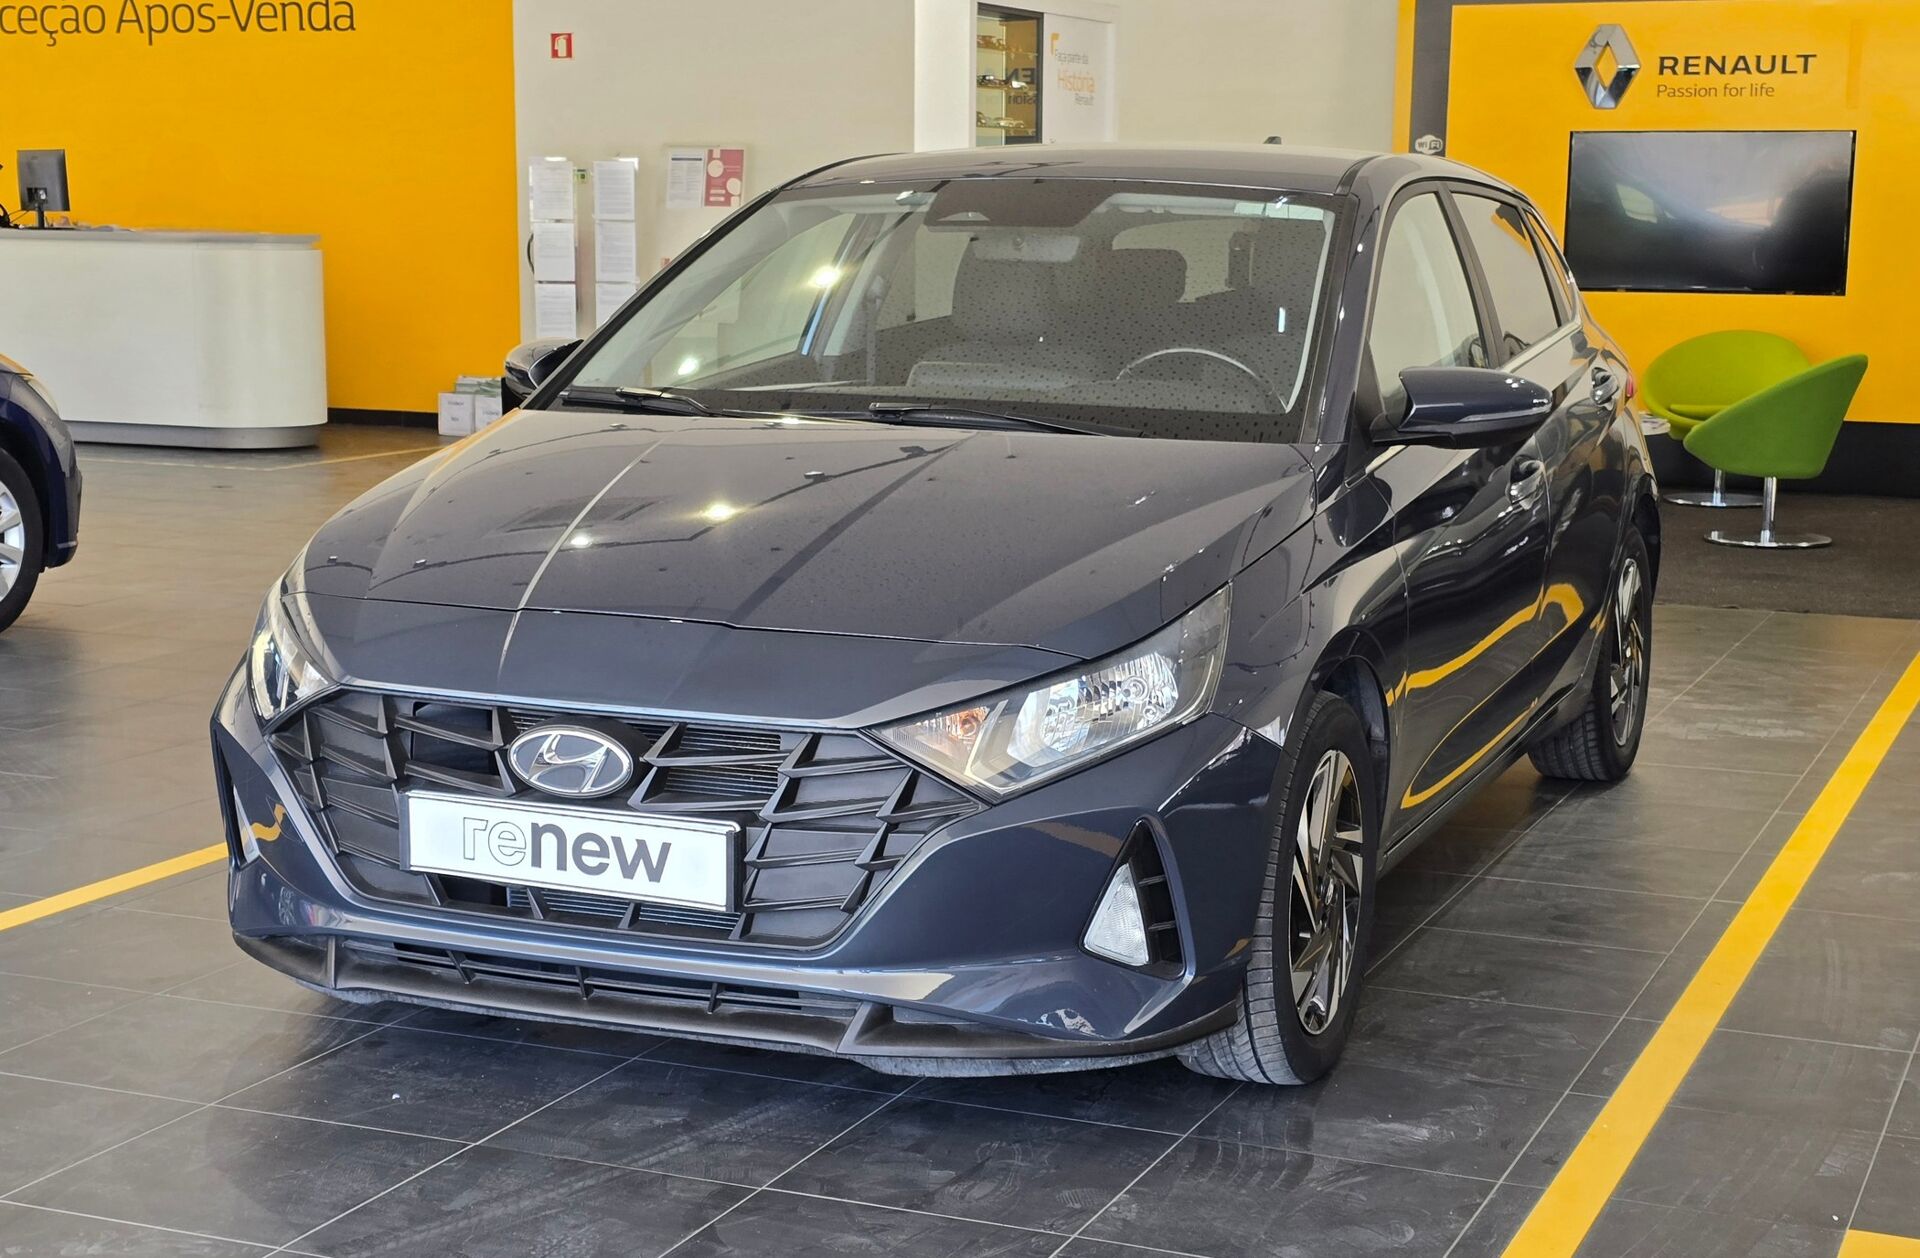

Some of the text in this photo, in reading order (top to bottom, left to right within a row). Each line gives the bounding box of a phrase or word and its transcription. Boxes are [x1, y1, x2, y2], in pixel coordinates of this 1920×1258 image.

[1658, 54, 1817, 76] RENAULT
[1656, 82, 1775, 98] Passion for life
[463, 816, 672, 883] renew
